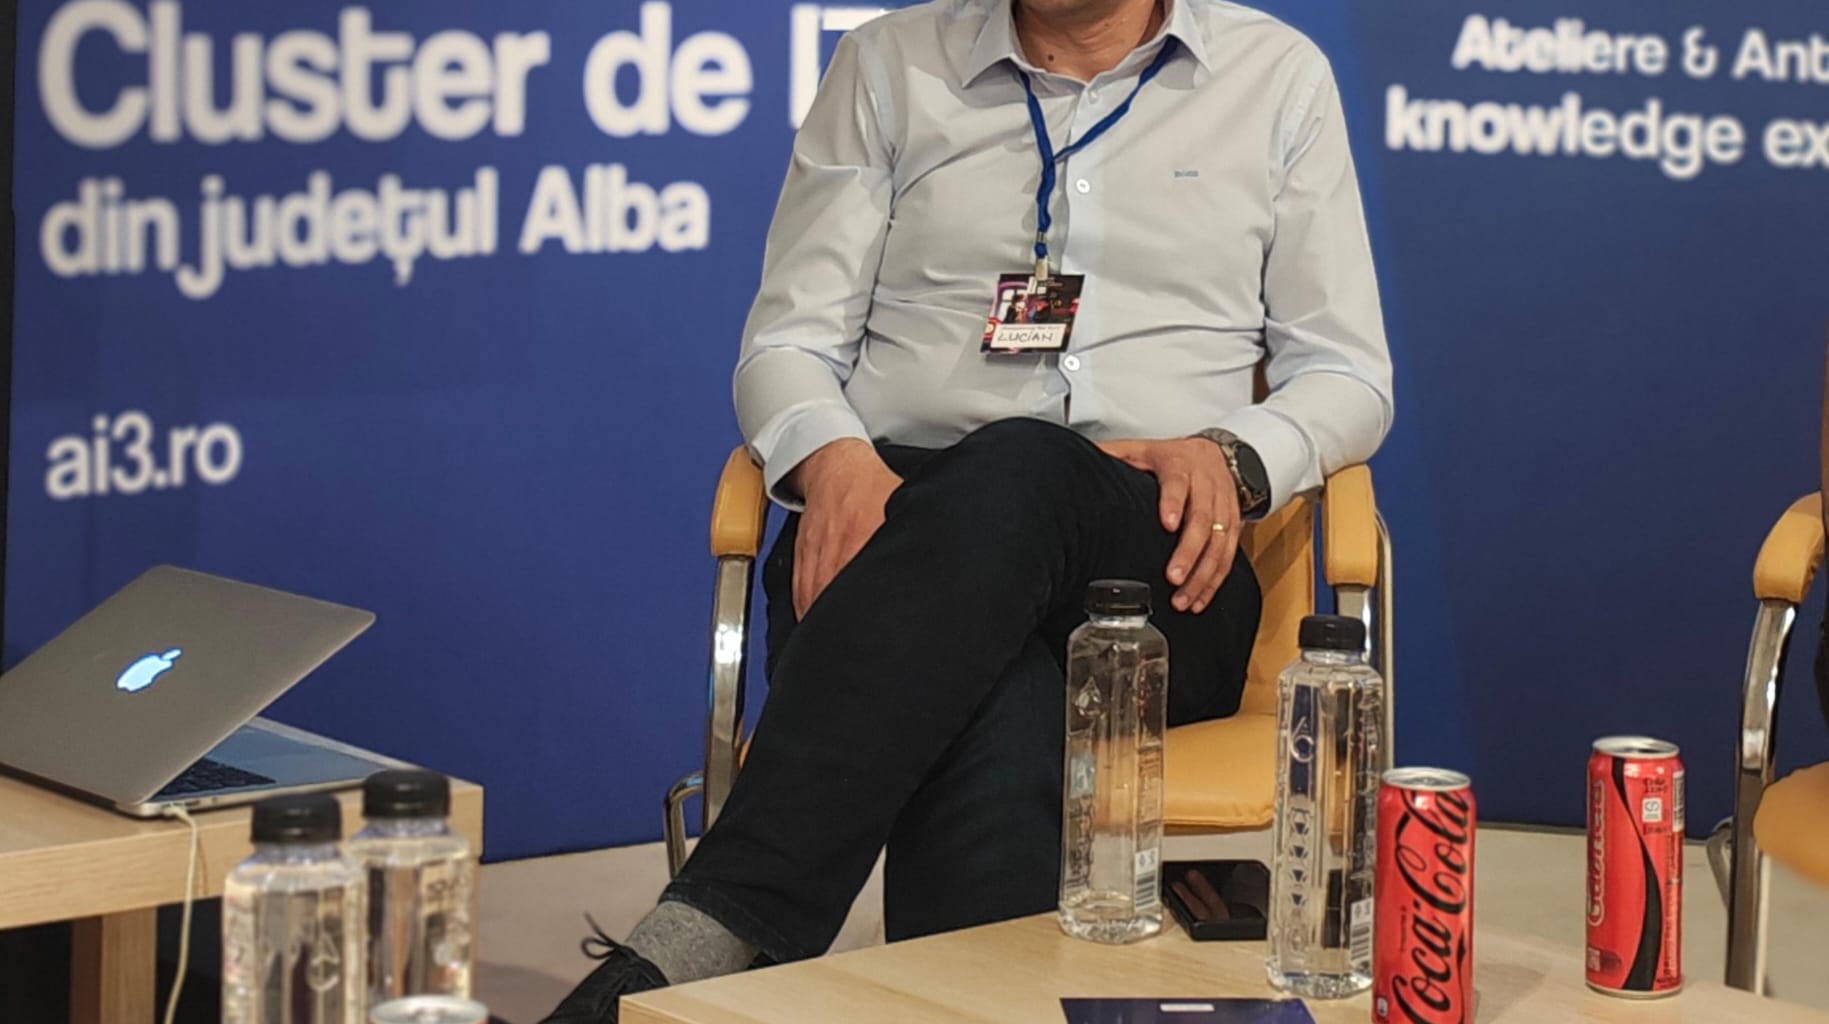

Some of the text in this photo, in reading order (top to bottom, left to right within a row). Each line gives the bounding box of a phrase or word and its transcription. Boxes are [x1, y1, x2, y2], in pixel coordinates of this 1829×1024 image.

[583, 0, 754, 138] de
[1452, 13, 1668, 73] Ateliere
[1682, 26, 1717, 79] &
[1385, 83, 1745, 179] knowledge
[40, 178, 180, 278] din
[517, 162, 711, 256] Alba
[45, 409, 244, 501] ai3.ro
